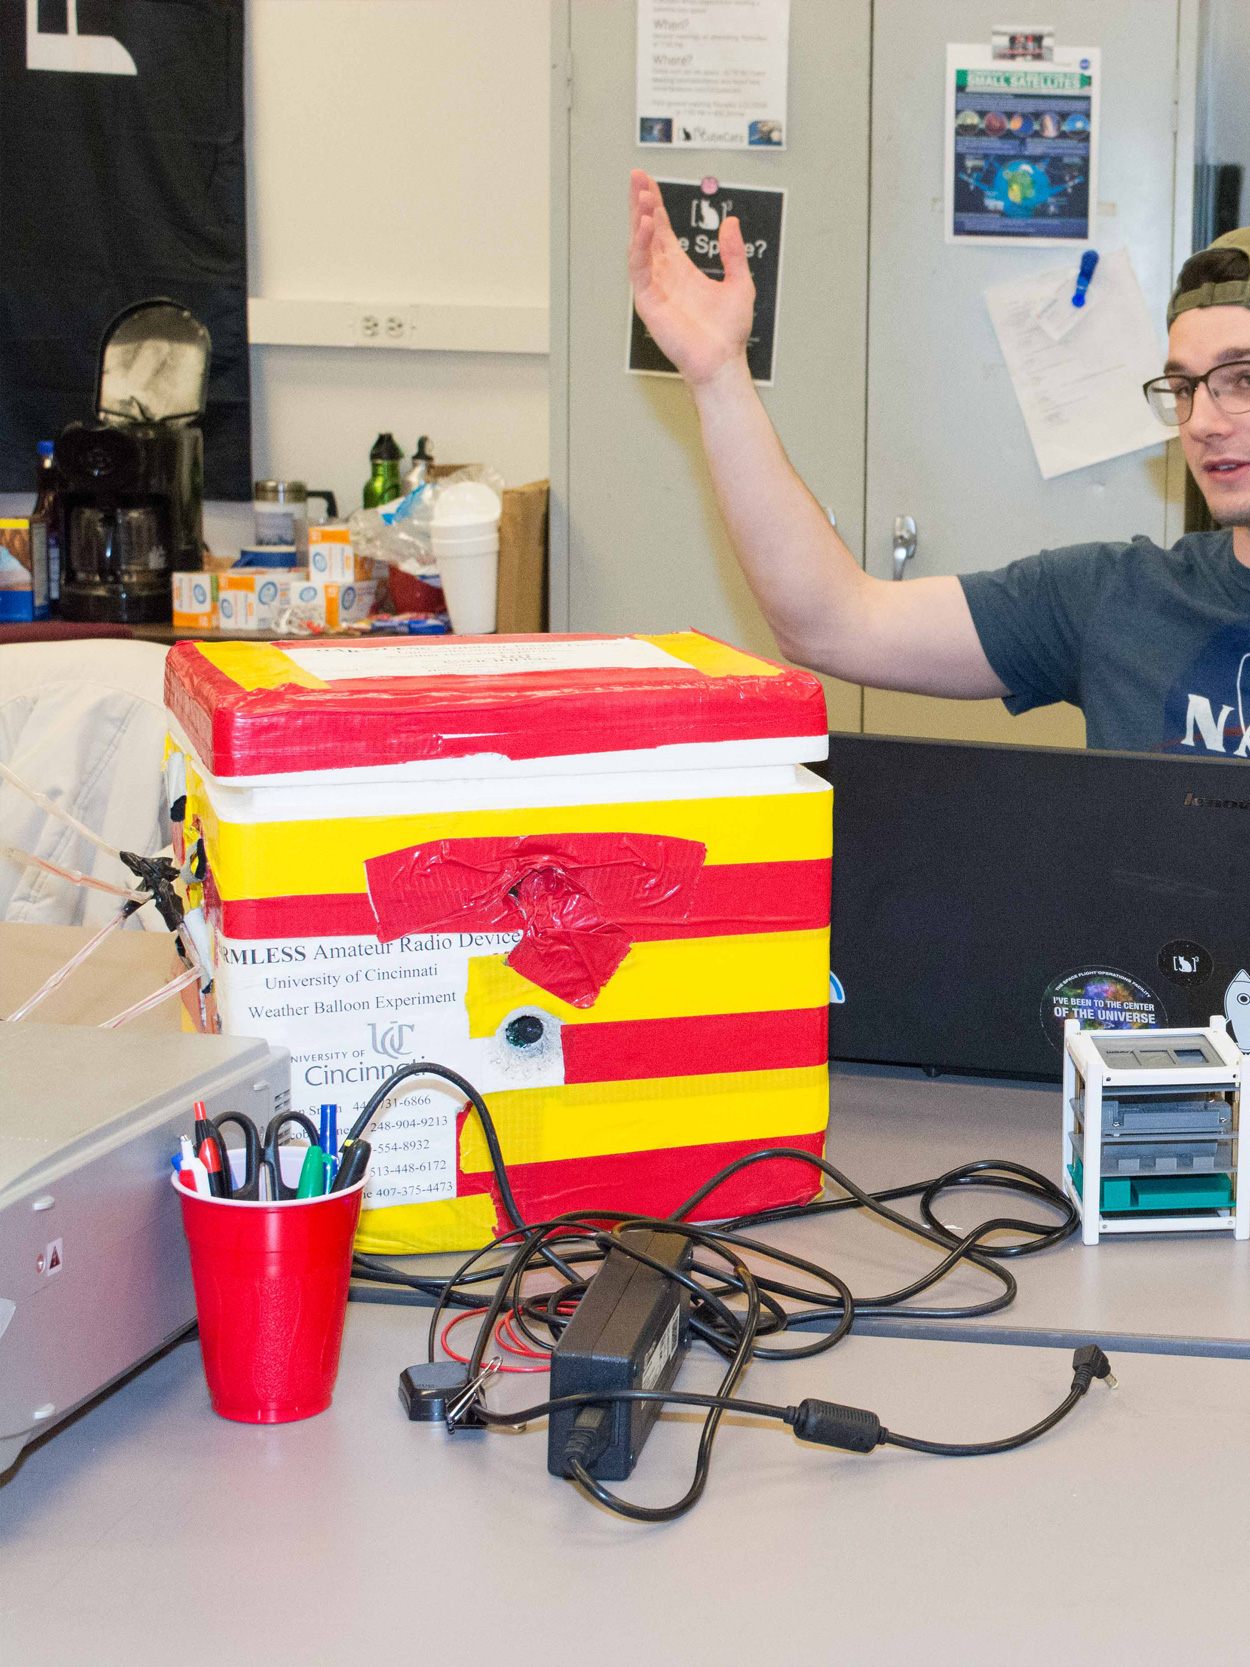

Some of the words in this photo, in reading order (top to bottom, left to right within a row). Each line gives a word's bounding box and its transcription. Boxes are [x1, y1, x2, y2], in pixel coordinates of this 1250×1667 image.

[694, 234, 767, 258] Spe?
[222, 944, 307, 966] RMLESS
[314, 942, 393, 961] Amateur
[400, 934, 452, 953] Radio
[459, 931, 521, 948] Device
[265, 971, 341, 990] University
[345, 969, 362, 984] of
[365, 963, 438, 982] Cincinnati
[1063, 974, 1078, 985] SPACE
[1097, 970, 1132, 984] OPERATIONS
[1131, 981, 1152, 998] FACILITY
[248, 1003, 310, 1019] Weather
[314, 1000, 370, 1015] Balloon
[375, 991, 457, 1010] Experiment
[1053, 996, 1069, 1006] I'VE
[1070, 998, 1092, 1007] BEEN
[1093, 999, 1105, 1008] TO
[1105, 1000, 1122, 1010] THE
[1123, 1001, 1155, 1012] CENTER
[1054, 1006, 1069, 1018] OF
[1072, 1007, 1095, 1020] THE
[1097, 1010, 1156, 1025] UNIVERSE
[290, 1051, 348, 1063] NIVERSITY
[352, 1049, 366, 1059] OF
[370, 1115, 448, 1133] 248-904-9213
[373, 1138, 430, 1155] -554-8932
[370, 1160, 447, 1178] 513-448-6172
[376, 1181, 453, 1197] 407-375-4473
